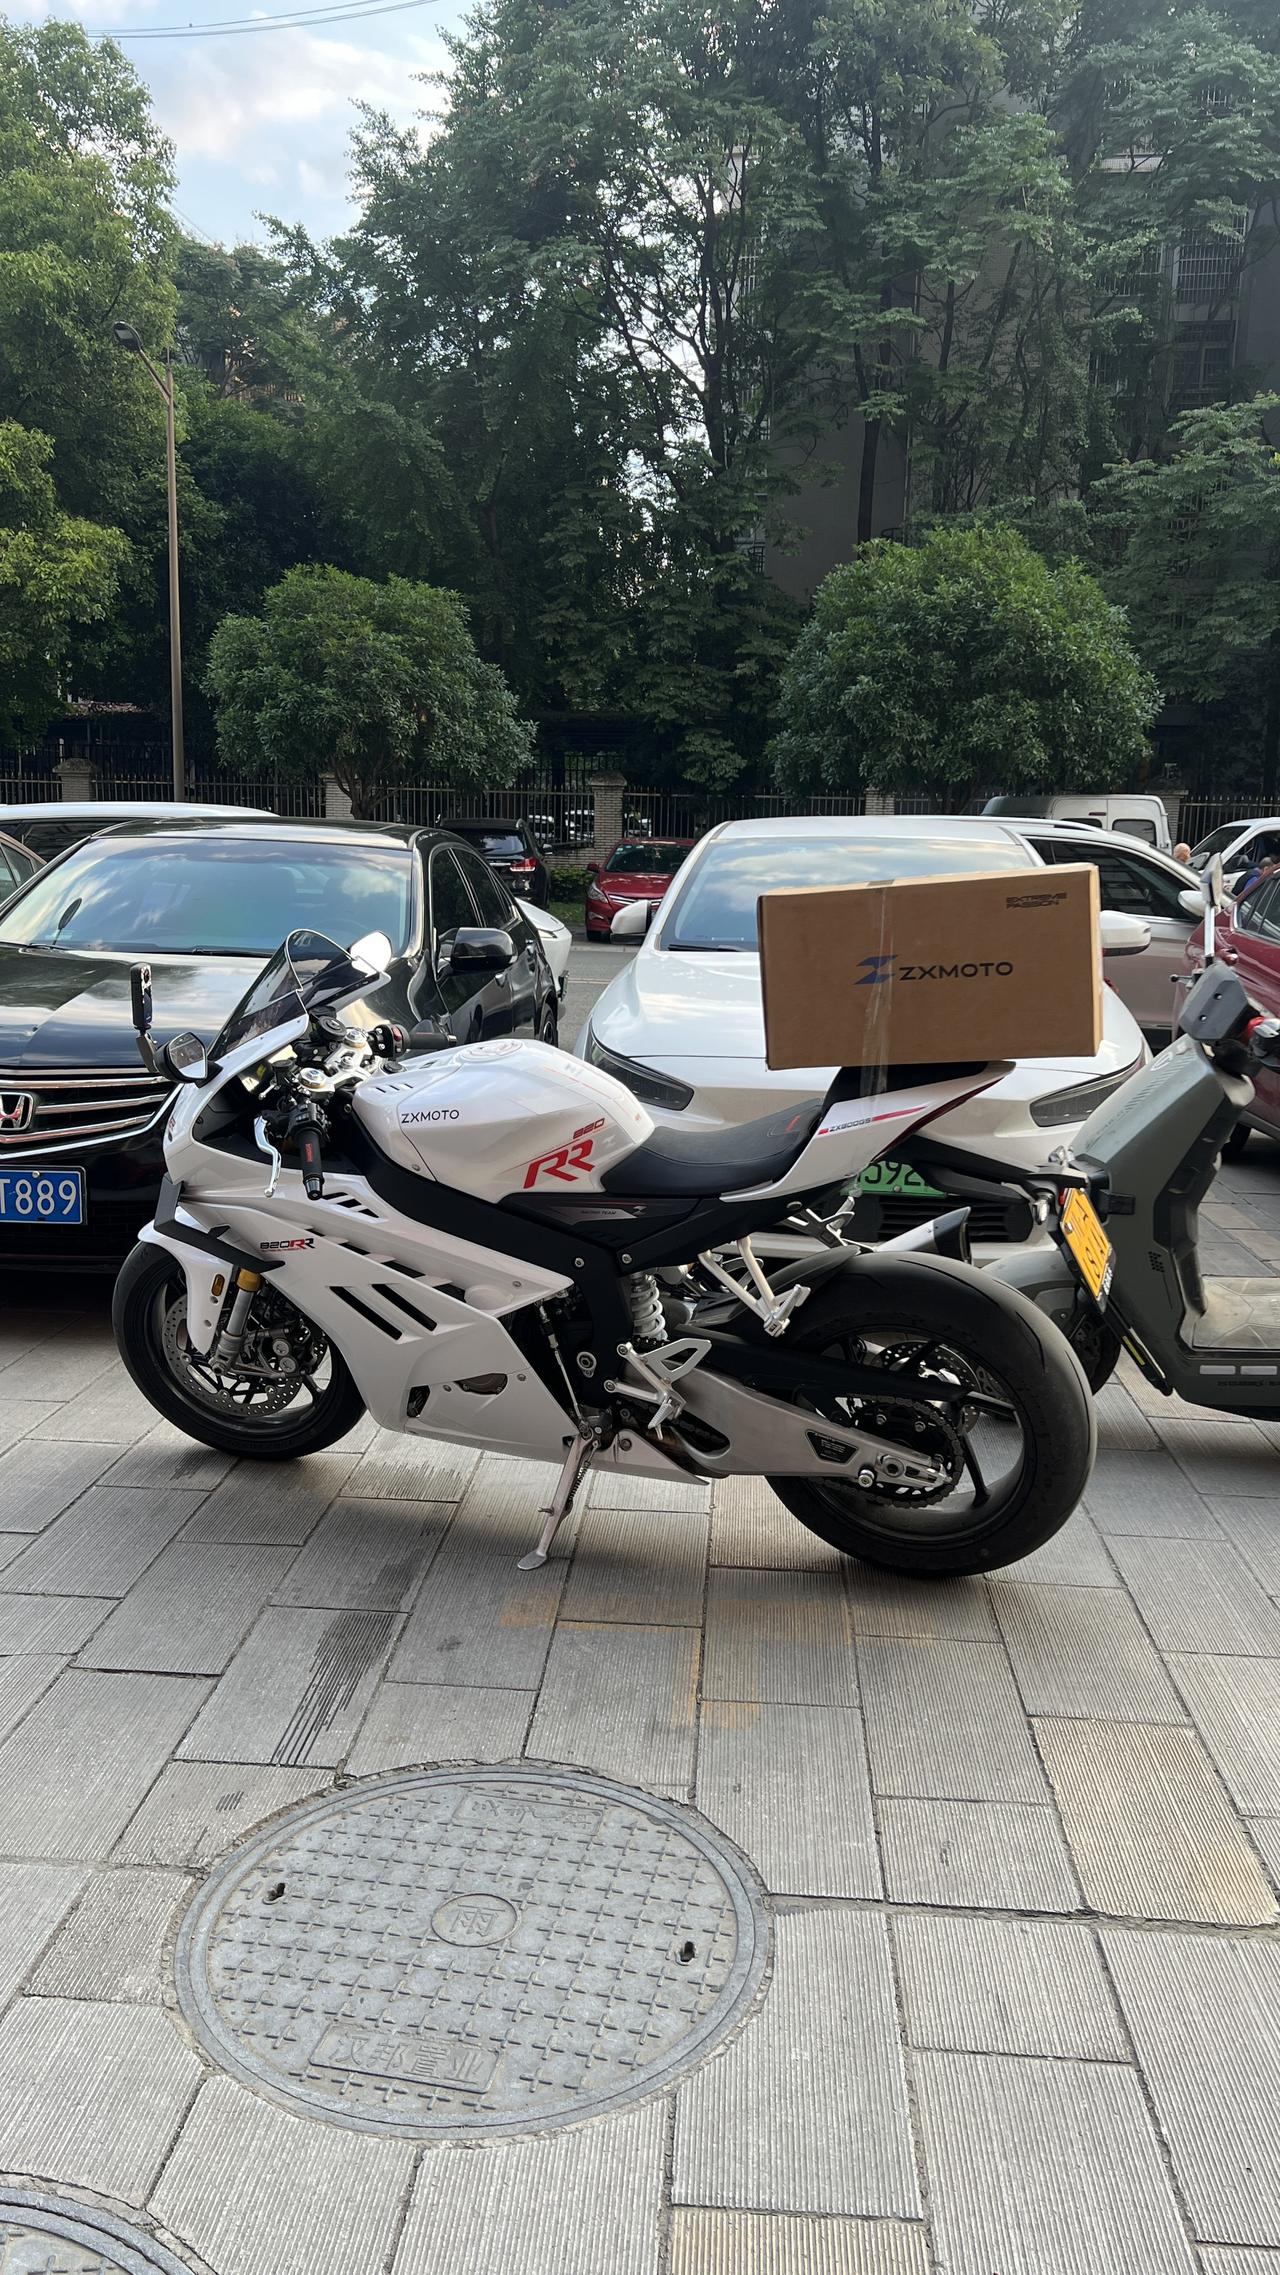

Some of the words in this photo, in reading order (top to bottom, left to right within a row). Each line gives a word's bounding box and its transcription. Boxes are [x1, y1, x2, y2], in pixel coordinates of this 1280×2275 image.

[898, 961, 1014, 981] ZXMOTO
[401, 1109, 460, 1124] ZXMOTO
[573, 1118, 605, 1139] 820
[523, 1139, 595, 1189] RR
[0, 1178, 77, 1215] T889
[260, 1238, 316, 1249] 820RR
[449, 1903, 505, 1937] 雨
[329, 2032, 478, 2085] 汉邦置业
